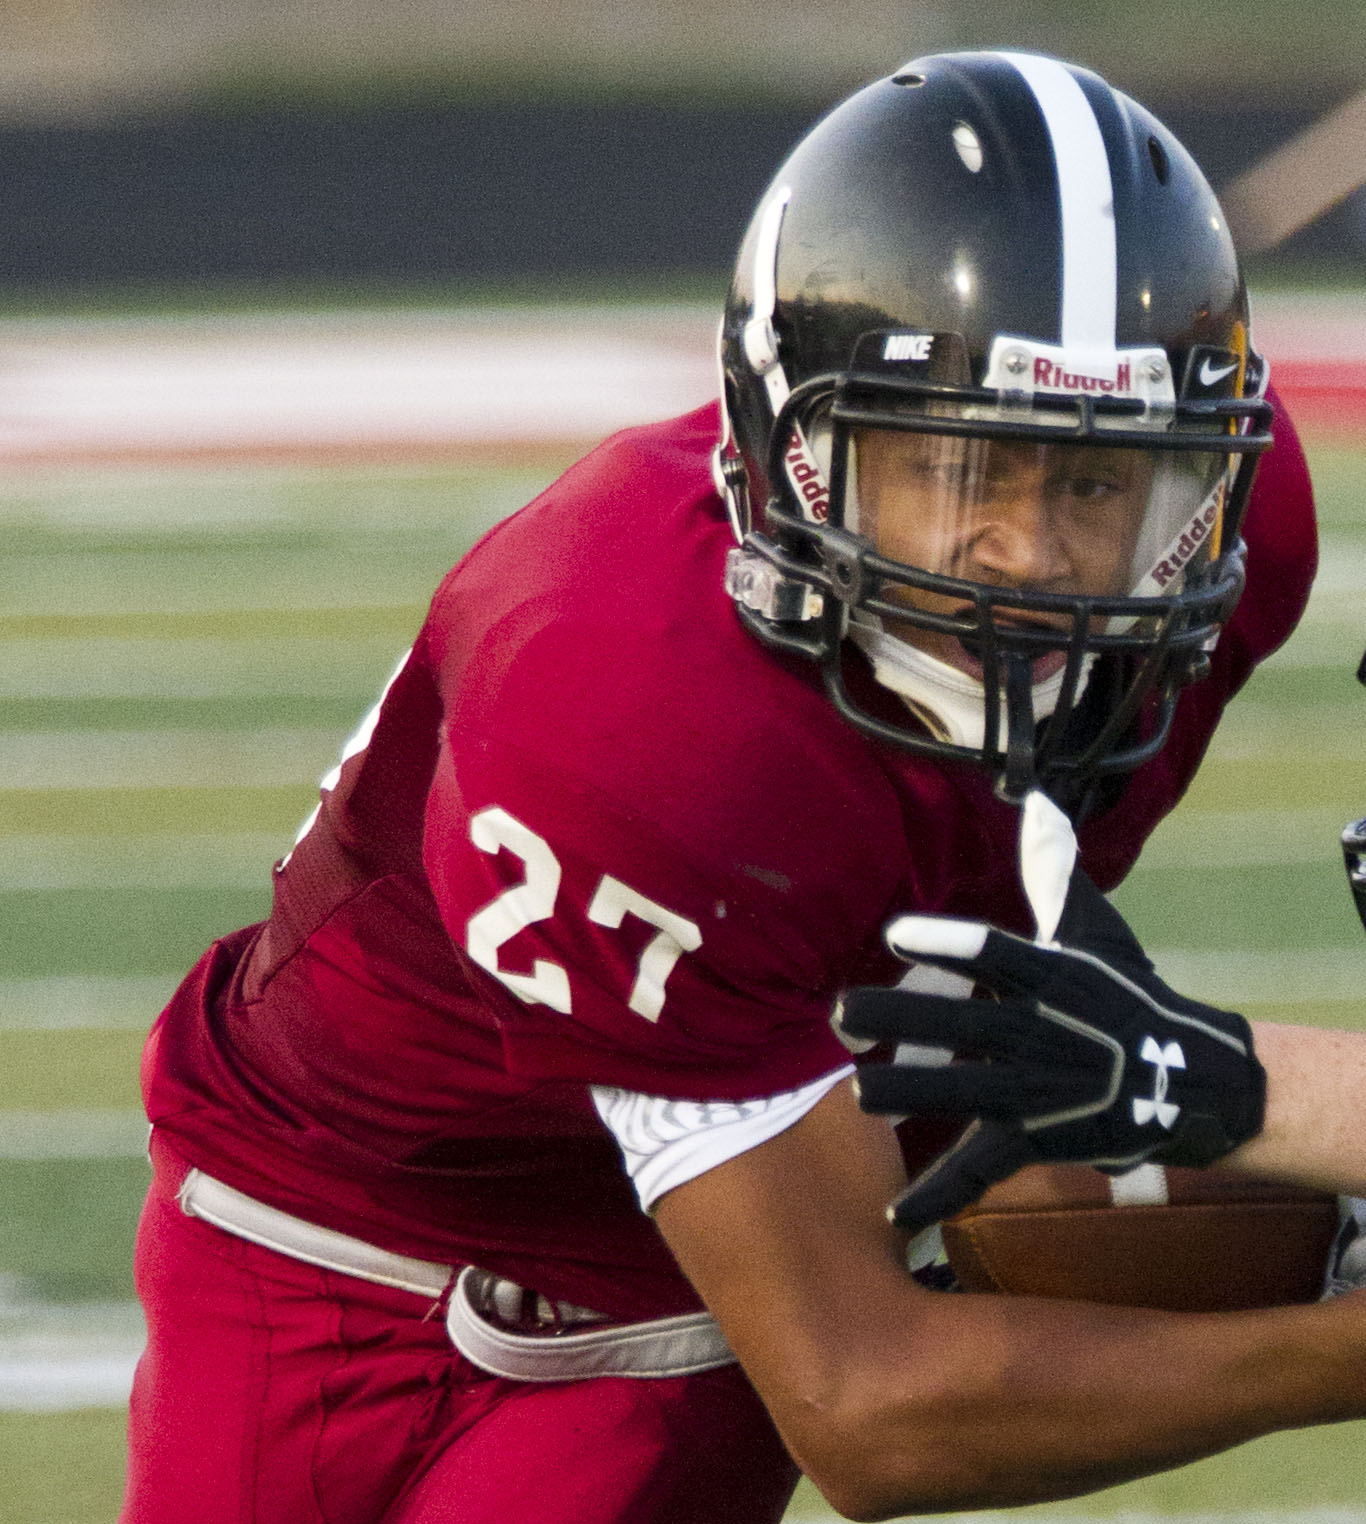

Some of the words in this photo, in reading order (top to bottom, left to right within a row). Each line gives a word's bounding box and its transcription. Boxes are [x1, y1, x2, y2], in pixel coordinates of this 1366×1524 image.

[883, 335, 935, 360] NIKE
[786, 429, 830, 521] Ridde
[466, 806, 703, 1024] 27
